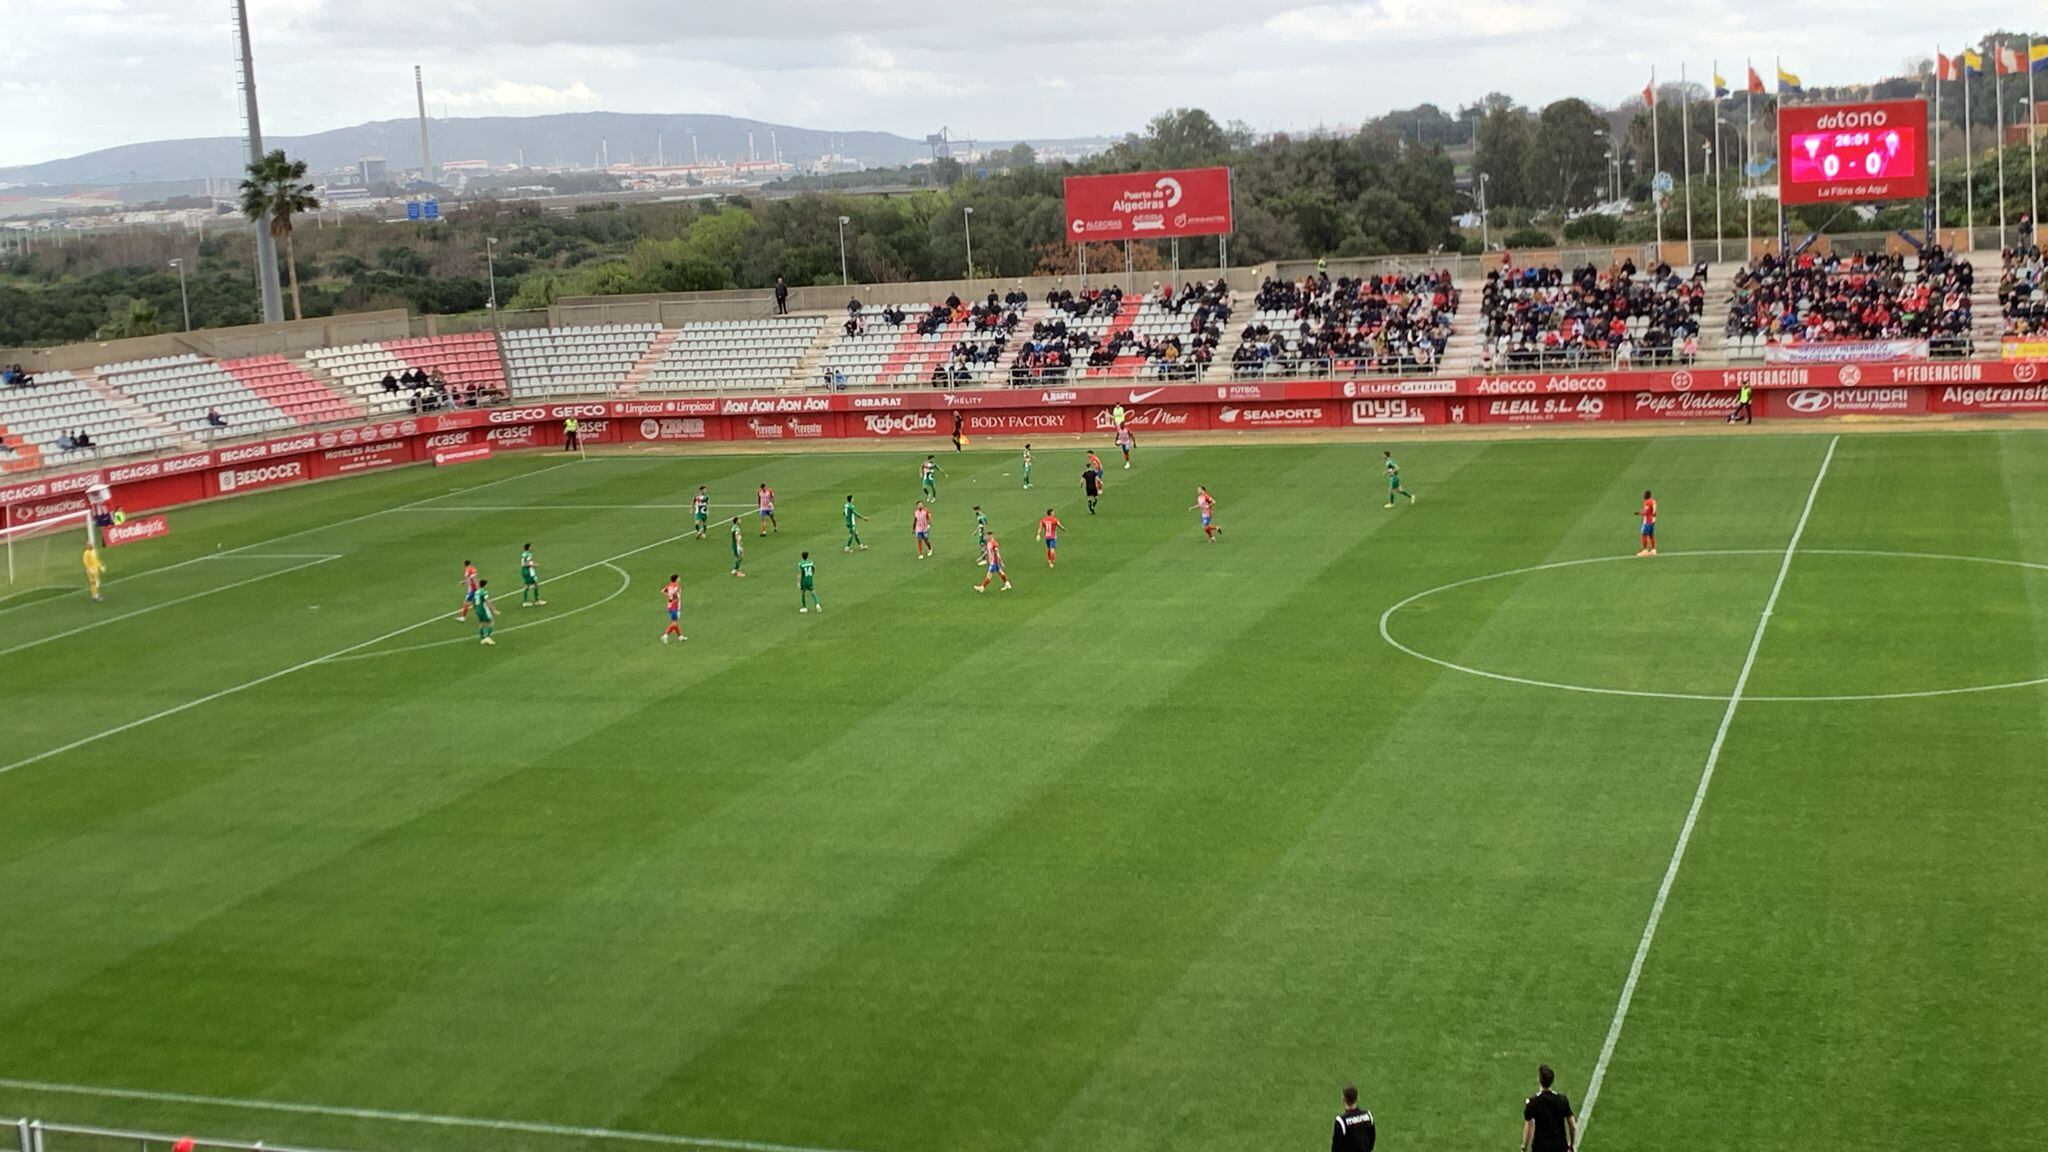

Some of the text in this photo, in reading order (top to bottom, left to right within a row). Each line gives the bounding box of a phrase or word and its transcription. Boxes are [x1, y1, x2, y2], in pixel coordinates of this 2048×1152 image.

[1817, 110, 1887, 129] datono
[1823, 154, 1839, 176] 0
[1865, 151, 1881, 174] 0
[1124, 190, 1164, 200] Puerto de
[1818, 187, 1830, 198] La
[1854, 185, 1866, 195] de
[1112, 199, 1164, 214] Algeciras
[1906, 363, 1982, 382] FEDERACIÓN
[1477, 378, 1536, 394] Adecco
[1546, 376, 1607, 392] Adecco
[854, 397, 902, 407] OBRAMAT
[1833, 388, 1908, 402] HYUNDAI
[723, 400, 748, 413] AON
[749, 399, 775, 412] AON
[776, 398, 802, 411] AON
[803, 397, 829, 411] AON
[1489, 400, 1540, 415] ELEAL
[1543, 399, 1573, 413] S.L.
[1635, 392, 1676, 414] Pepe
[489, 408, 546, 423] GEFCO
[552, 405, 605, 418] GEFCO
[864, 413, 937, 434] KubeClub
[971, 415, 1065, 428] BODY FACTORY
[435, 431, 470, 447] caser
[496, 425, 534, 439] caser
[236, 461, 301, 486] BESOCCER
[0, 484, 47, 502] ECACOR
